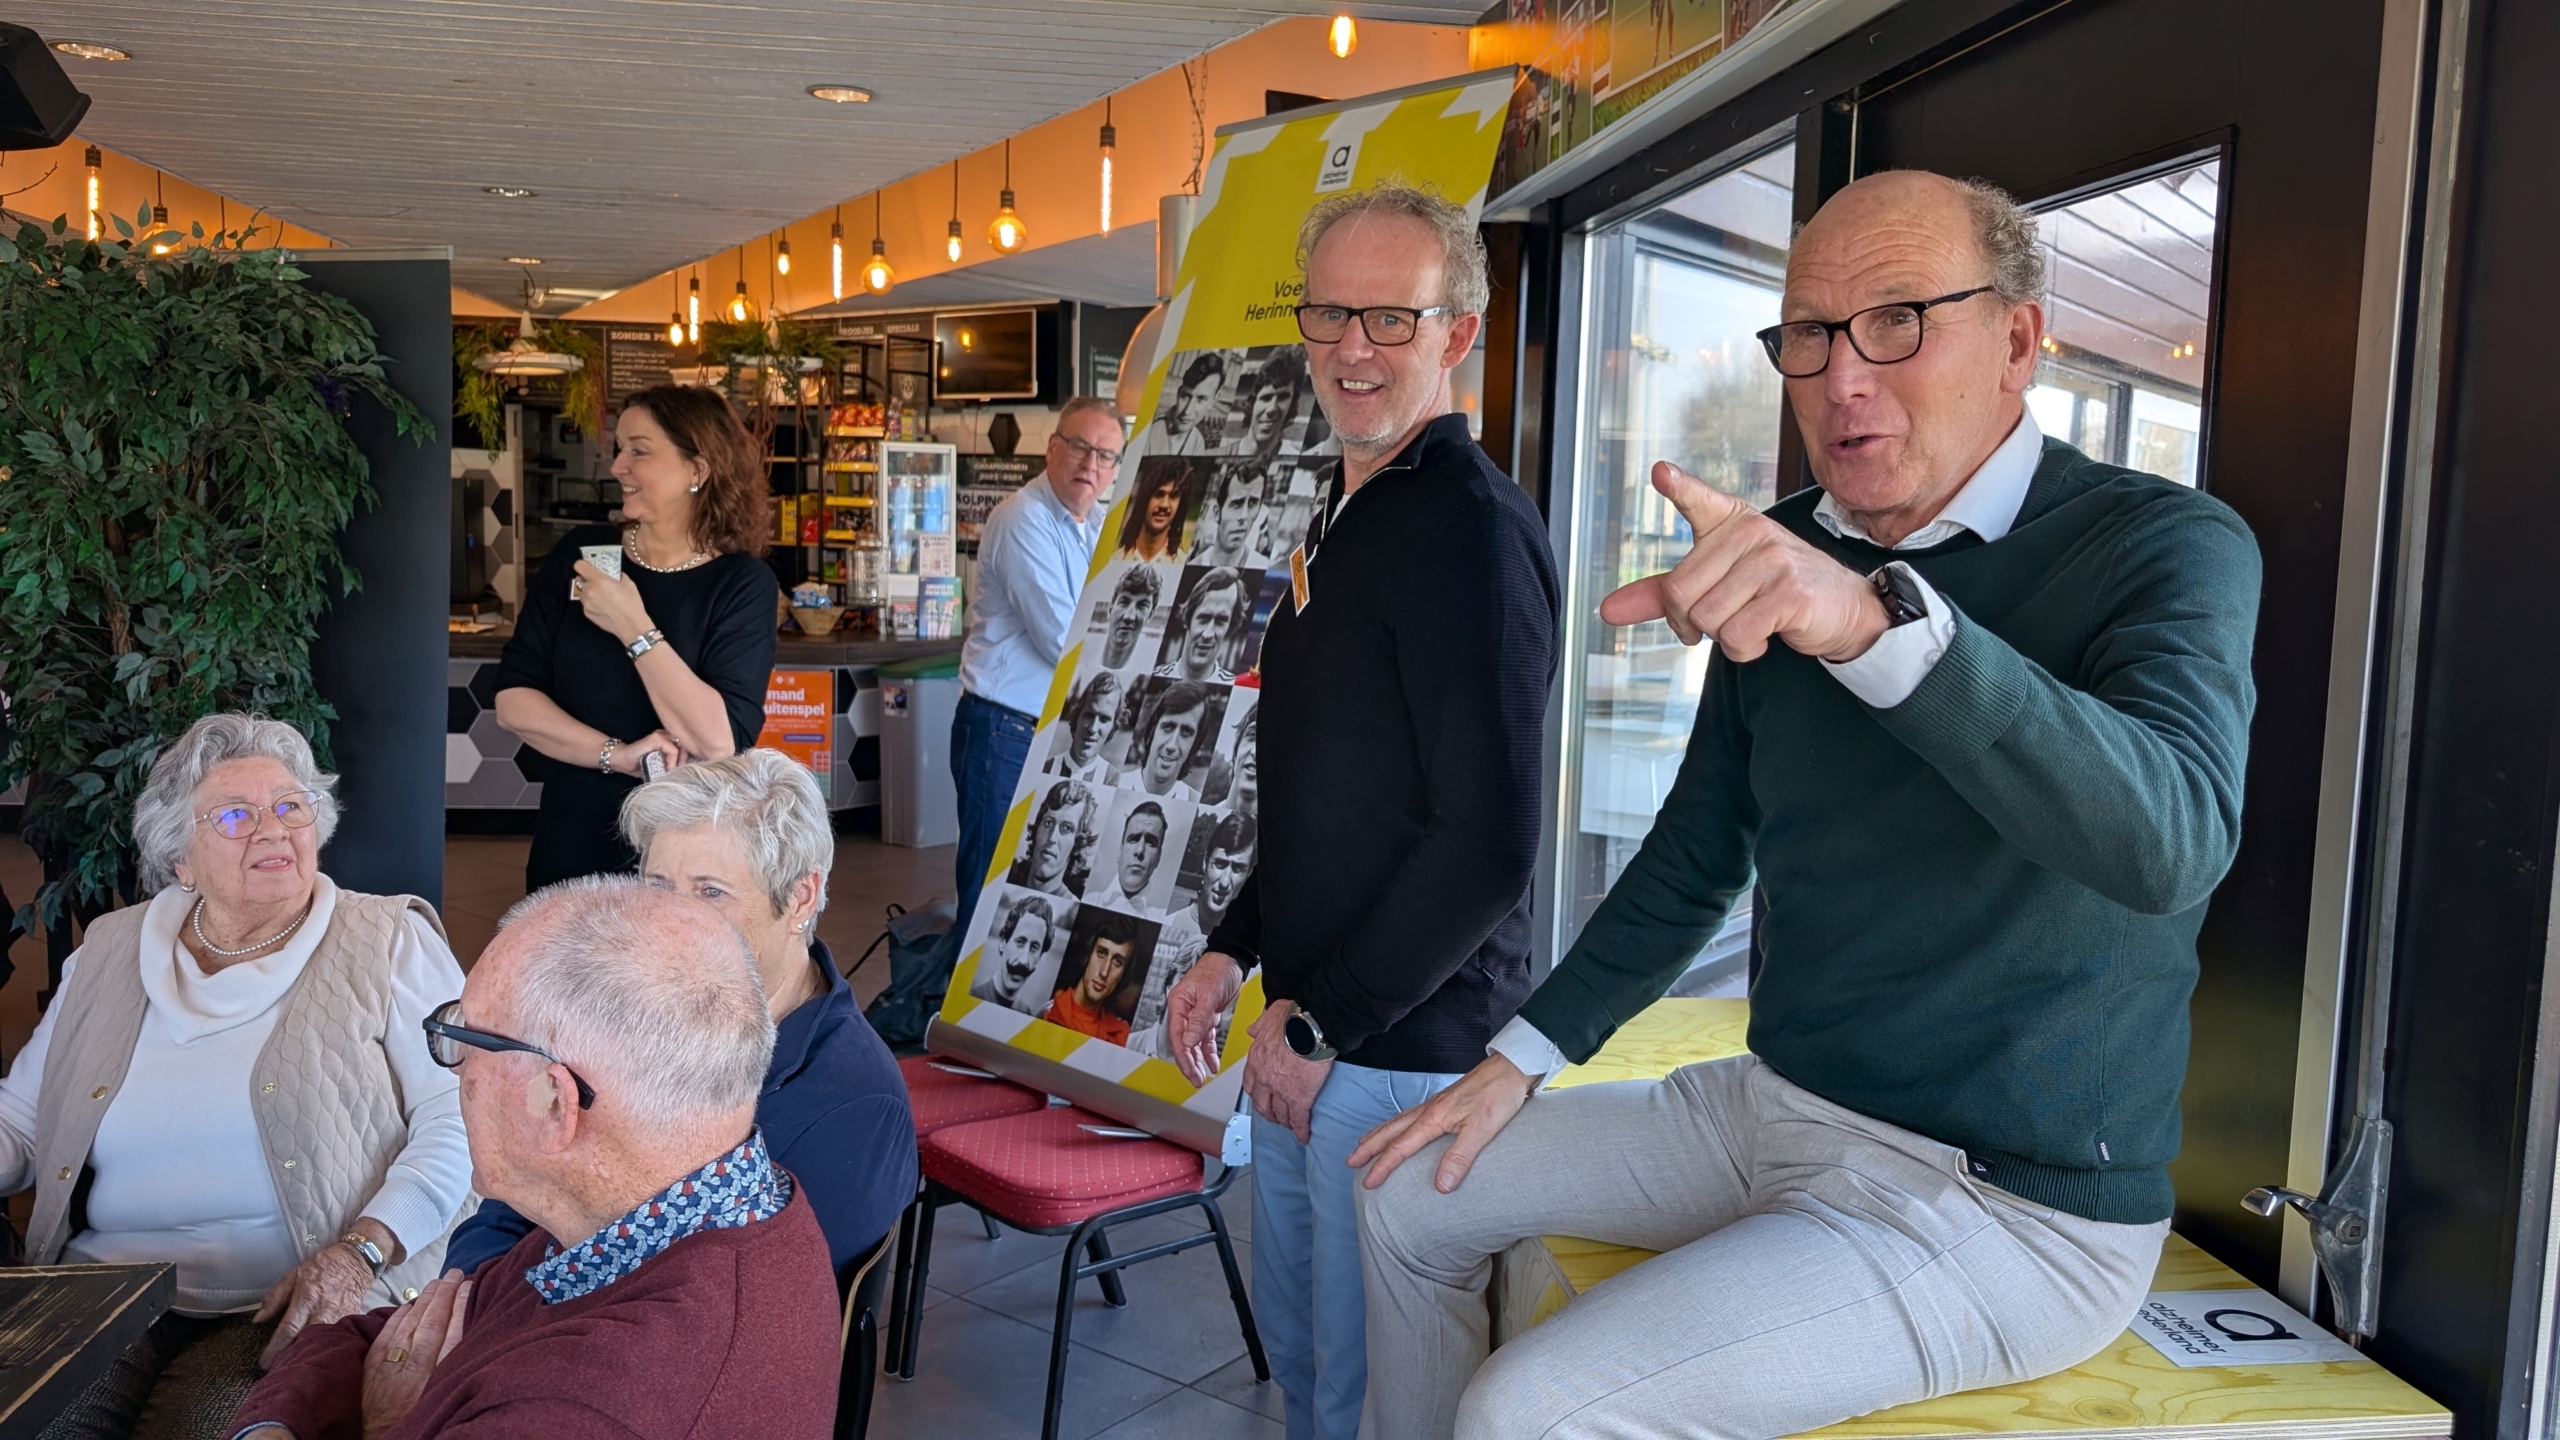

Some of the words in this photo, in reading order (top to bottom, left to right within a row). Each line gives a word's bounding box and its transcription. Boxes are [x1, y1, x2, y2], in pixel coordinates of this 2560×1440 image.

[1275, 281, 1304, 299] Voe
[1244, 301, 1295, 322] Herinn
[610, 331, 652, 341] ZONDER
[653, 333, 669, 342] PR
[886, 324, 920, 334] SPECIALS
[974, 463, 1028, 472] KAMPIOENEN
[766, 688, 805, 702] mand
[764, 702, 826, 718] uitenspel
[2137, 1307, 2208, 1354] ederland
[2149, 1302, 2227, 1353] alzheimer
[2204, 1309, 2302, 1341] a
